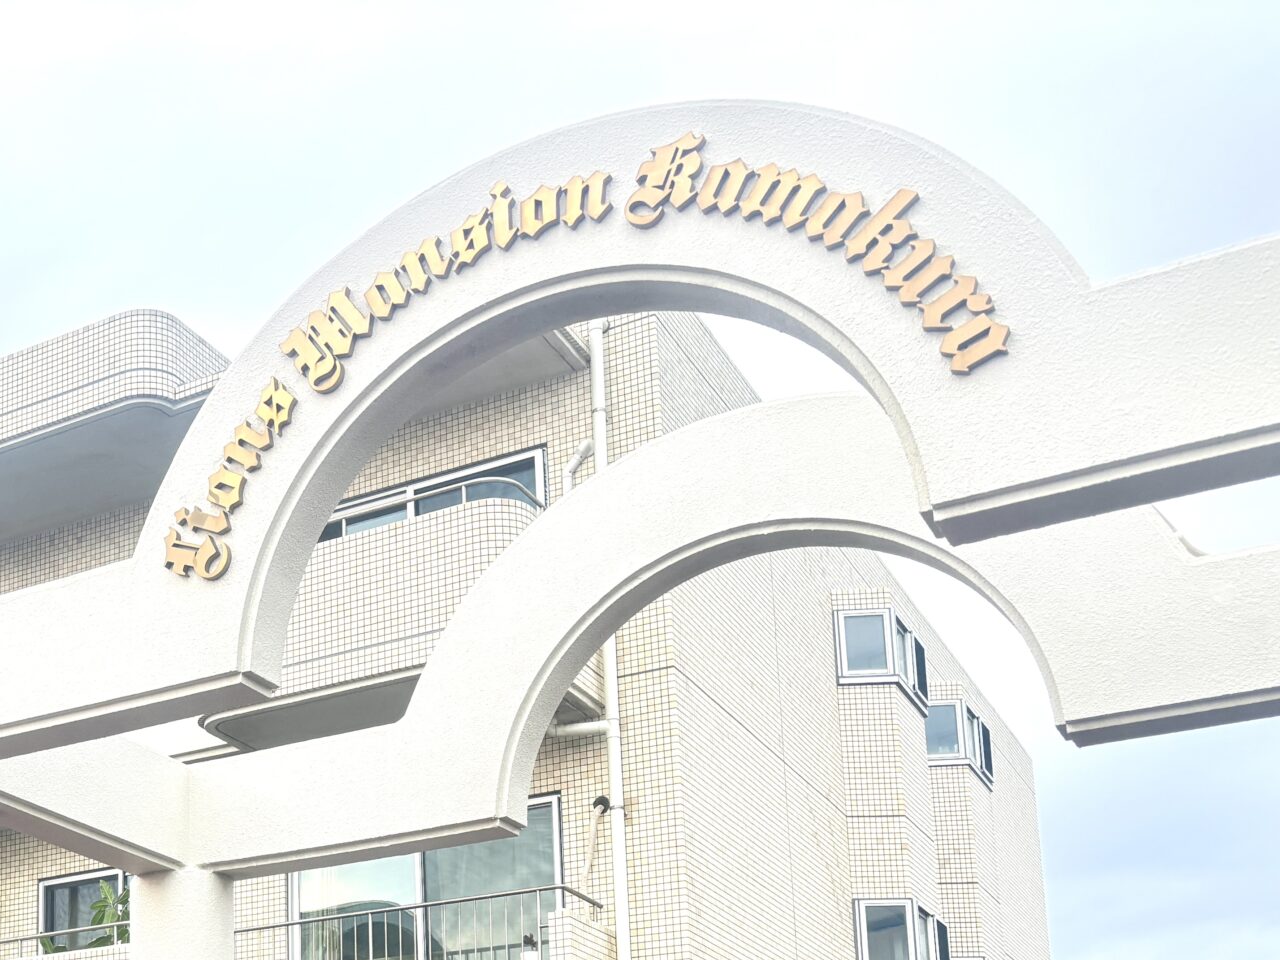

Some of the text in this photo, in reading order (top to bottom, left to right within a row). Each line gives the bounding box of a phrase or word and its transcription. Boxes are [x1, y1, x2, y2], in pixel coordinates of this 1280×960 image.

[164, 131, 1010, 581] Lions Mansion Kamakura
